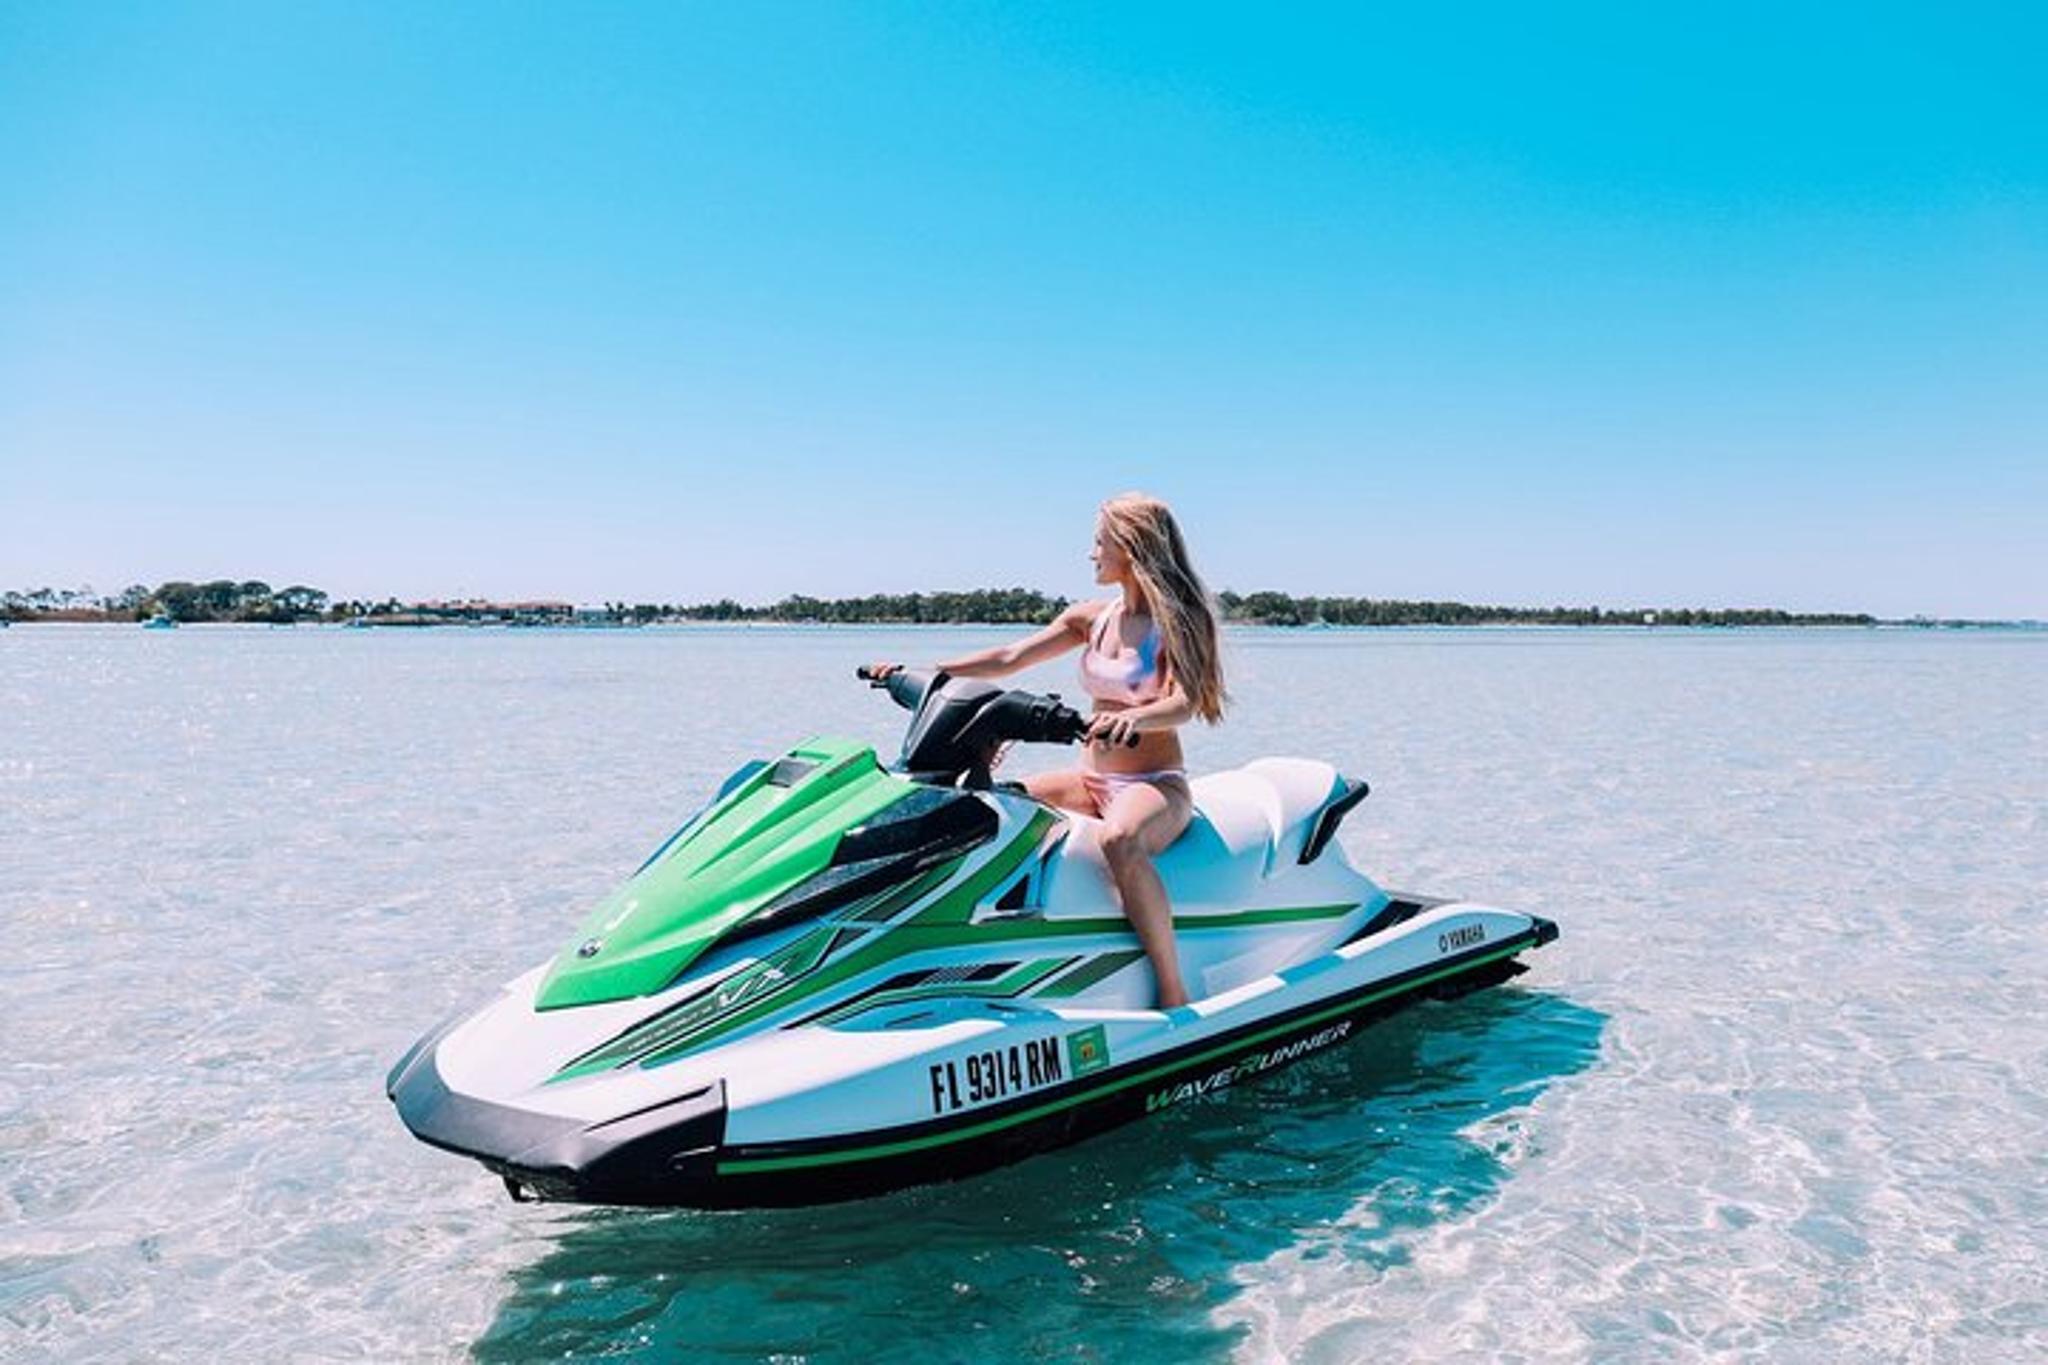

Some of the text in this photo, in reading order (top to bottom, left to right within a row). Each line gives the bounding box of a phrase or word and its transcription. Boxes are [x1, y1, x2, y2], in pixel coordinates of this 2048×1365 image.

[930, 1036, 1062, 1113] FL 9314 RM
[1146, 1021, 1352, 1112] WAVERUNNER
